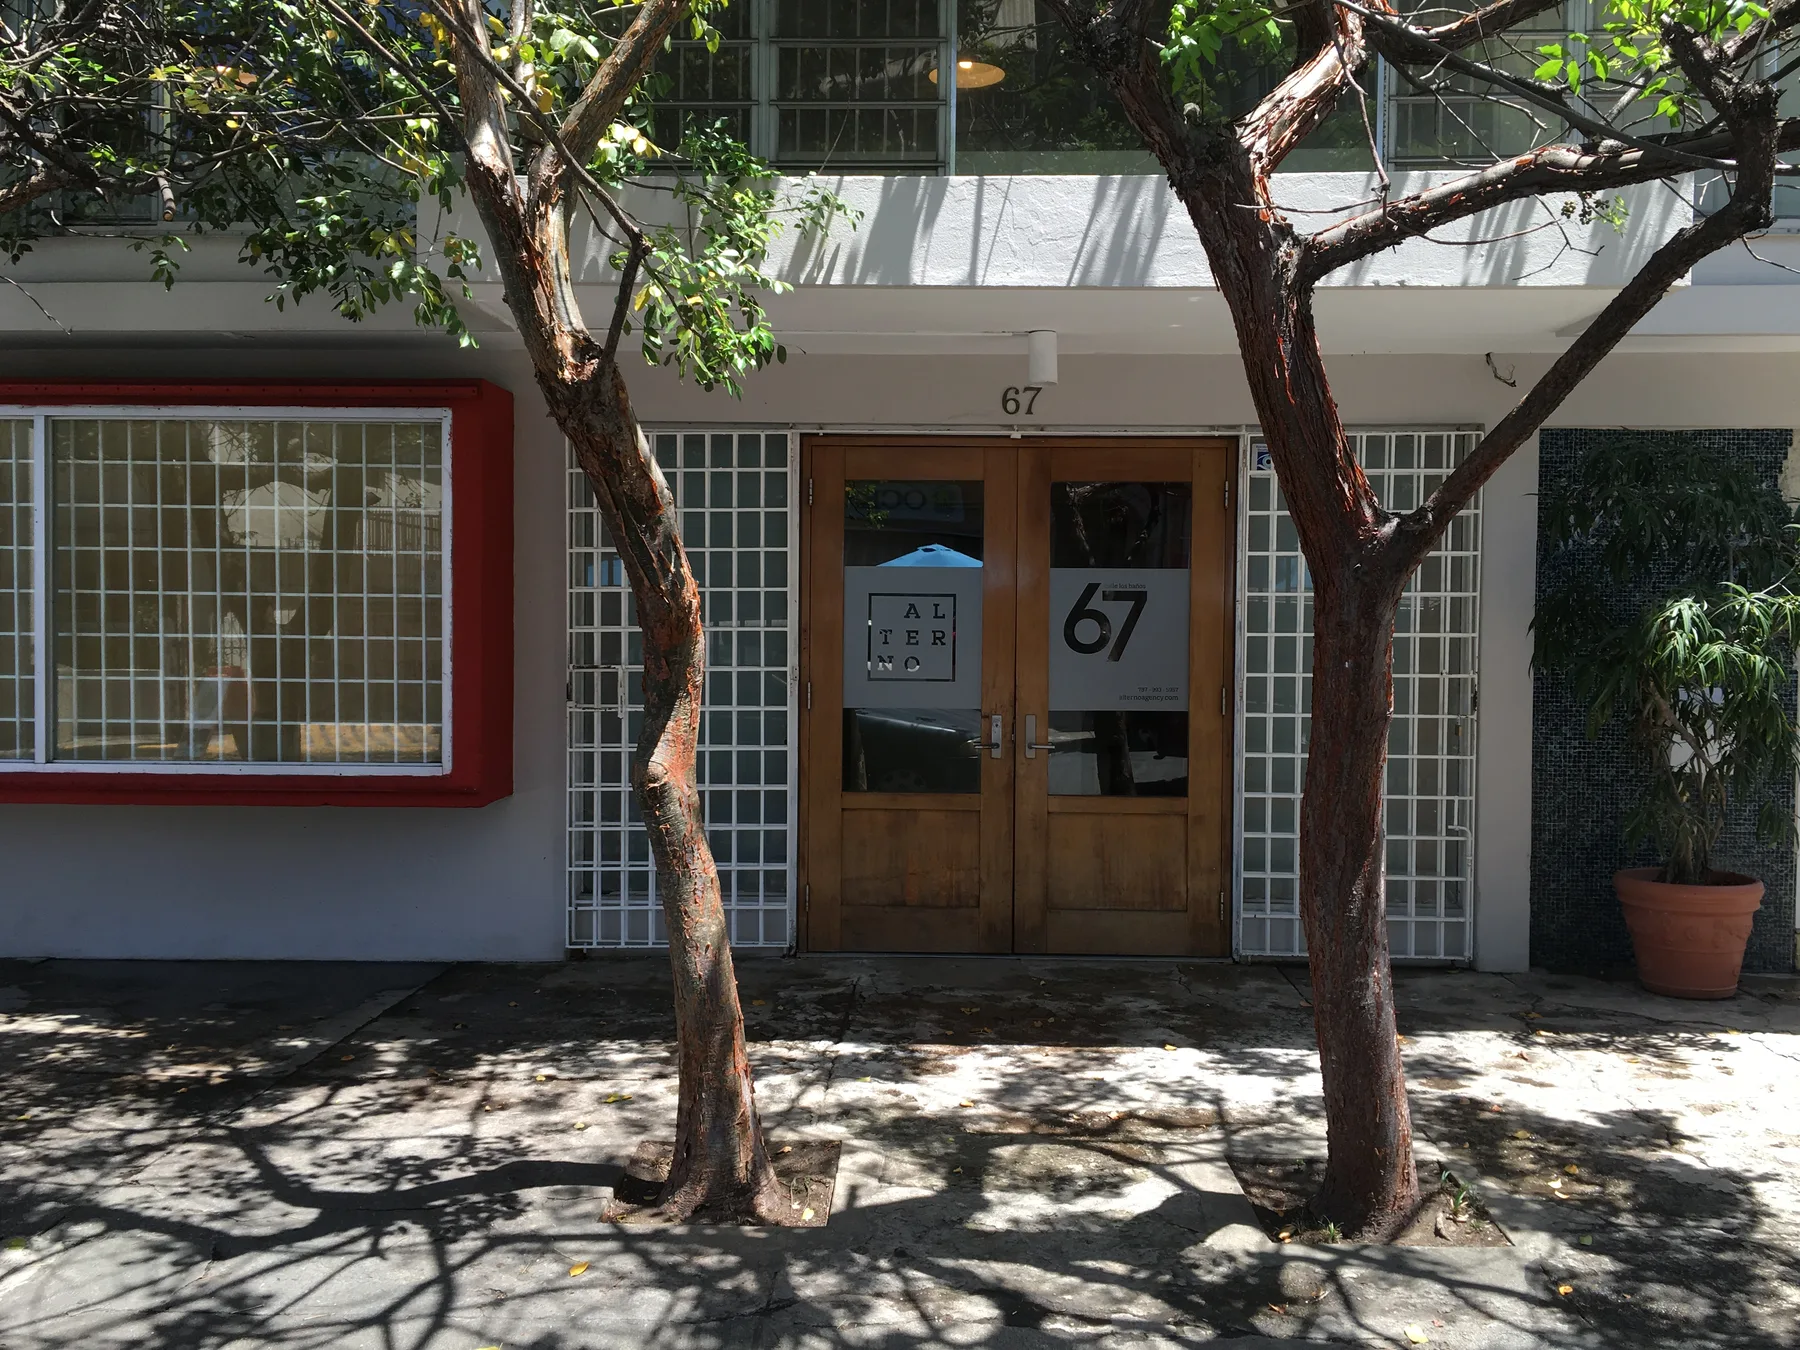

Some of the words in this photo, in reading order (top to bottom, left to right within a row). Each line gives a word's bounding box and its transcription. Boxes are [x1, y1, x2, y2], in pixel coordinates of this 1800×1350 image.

[1001, 387, 1043, 415] 67
[903, 603, 946, 619] AL
[1063, 582, 1148, 662] 67
[879, 629, 946, 646] TER
[877, 655, 921, 672] NO
